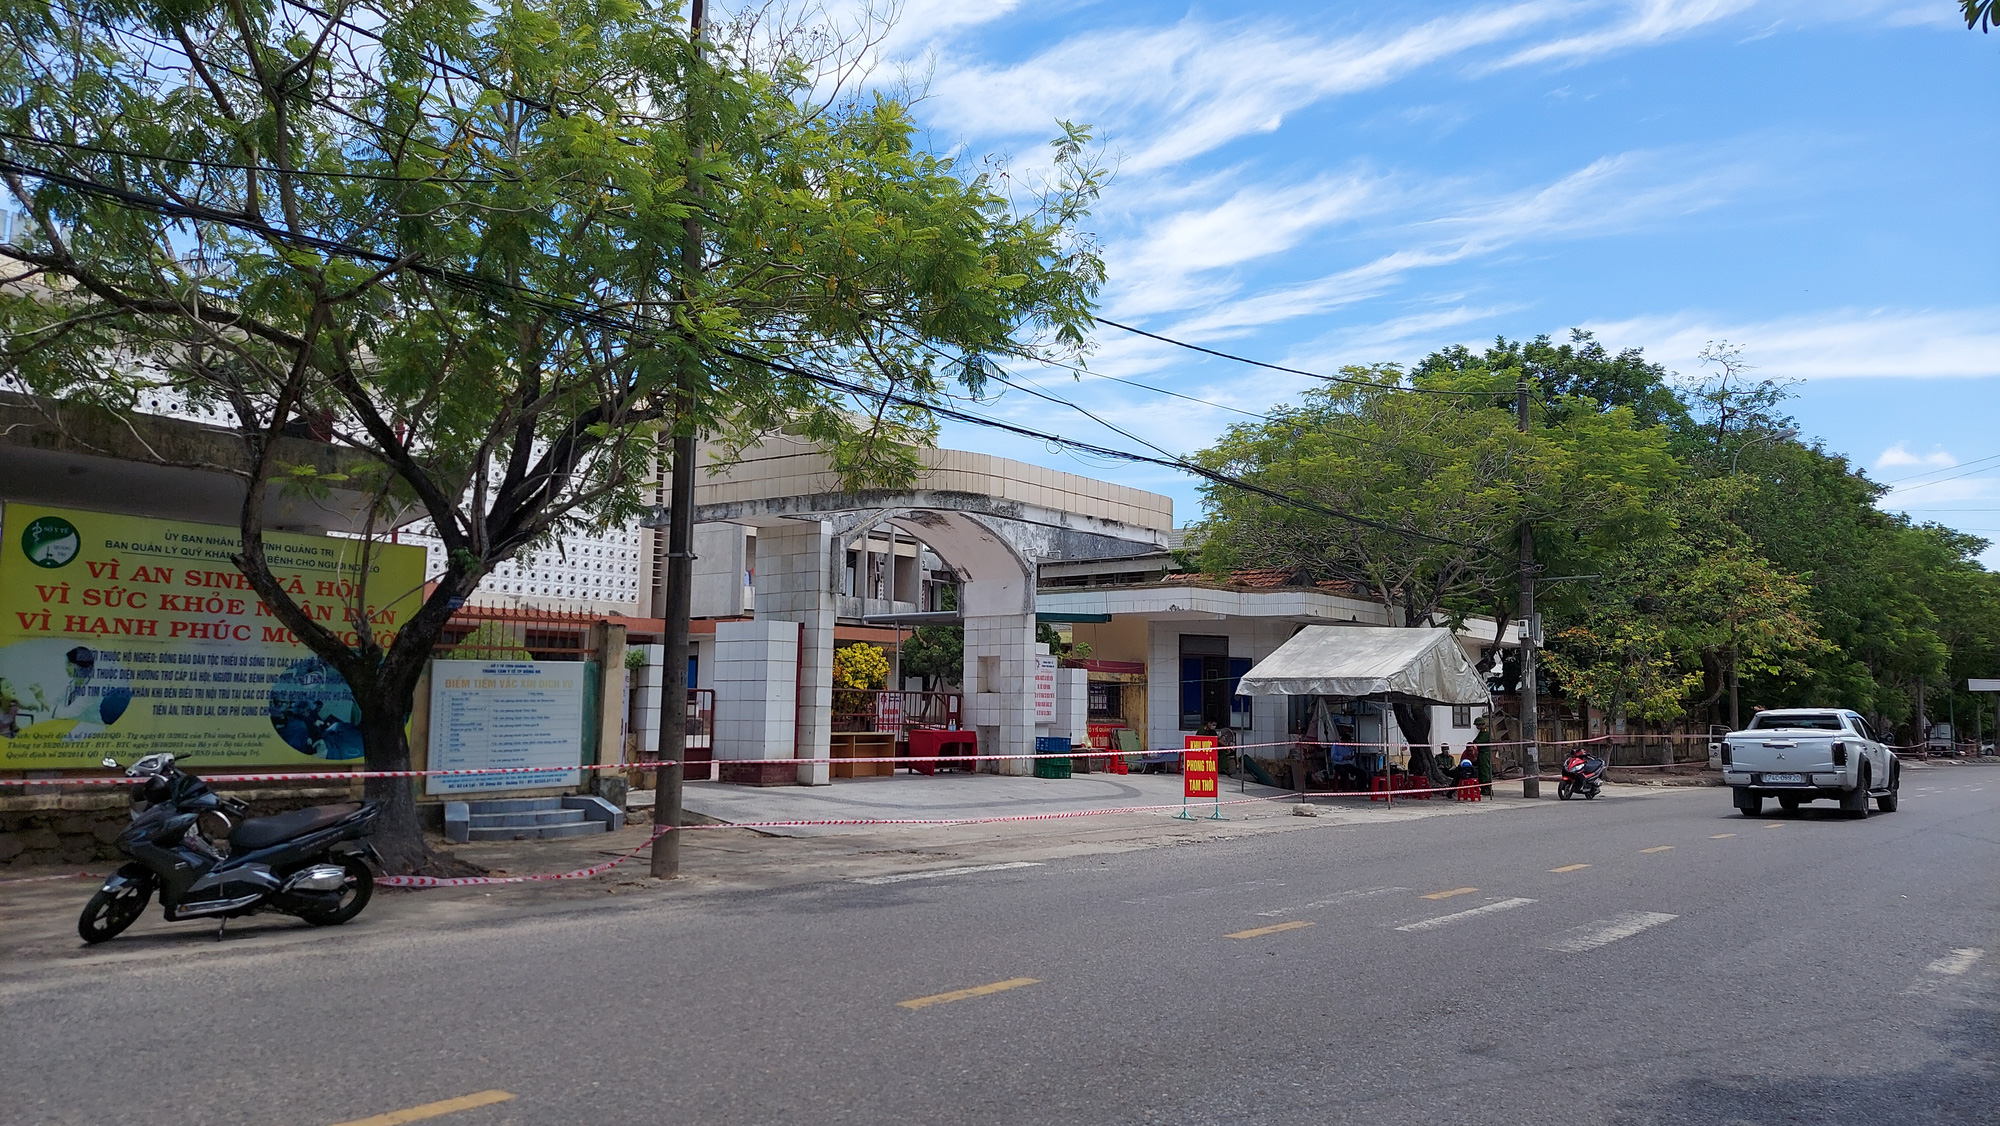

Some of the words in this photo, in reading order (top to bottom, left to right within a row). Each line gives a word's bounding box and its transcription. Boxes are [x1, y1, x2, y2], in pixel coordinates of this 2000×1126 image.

[164, 529, 179, 541] ỦY
[181, 534, 203, 544] BAN
[205, 536, 234, 547] NHÂN
[105, 540, 128, 549] BAN
[131, 542, 161, 552] QUẢN
[165, 544, 178, 554] LÝ
[180, 546, 202, 557] QUỸ
[205, 548, 235, 559] KHÁM
[262, 540, 282, 551] TỈNH
[284, 544, 318, 555] QUẢNG
[321, 548, 334, 558] TRỊ
[267, 555, 293, 566] BỆNH
[296, 558, 316, 567] CHO
[86, 558, 120, 580] VÌ
[129, 566, 174, 584] AN
[184, 569, 254, 590] SINH
[315, 579, 360, 601] HỘI
[35, 582, 71, 604] VÌ
[82, 586, 147, 609] SỨC
[159, 592, 246, 615] KHỎE
[255, 600, 334, 621] NÂN
[342, 605, 396, 625] DÂN
[16, 608, 51, 631] VÌ
[63, 614, 159, 638] HẠNH
[168, 619, 251, 641] PHÚC
[261, 626, 302, 647] MỌ
[445, 675, 470, 688] ĐIỂM
[474, 678, 496, 689] TIÊM
[520, 679, 537, 689] XIN
[1186, 760, 1205, 772] PHONG
[1205, 756, 1216, 772] TỎA
[1189, 779, 1201, 794] TẠM
[1202, 777, 1214, 791] THỜI
